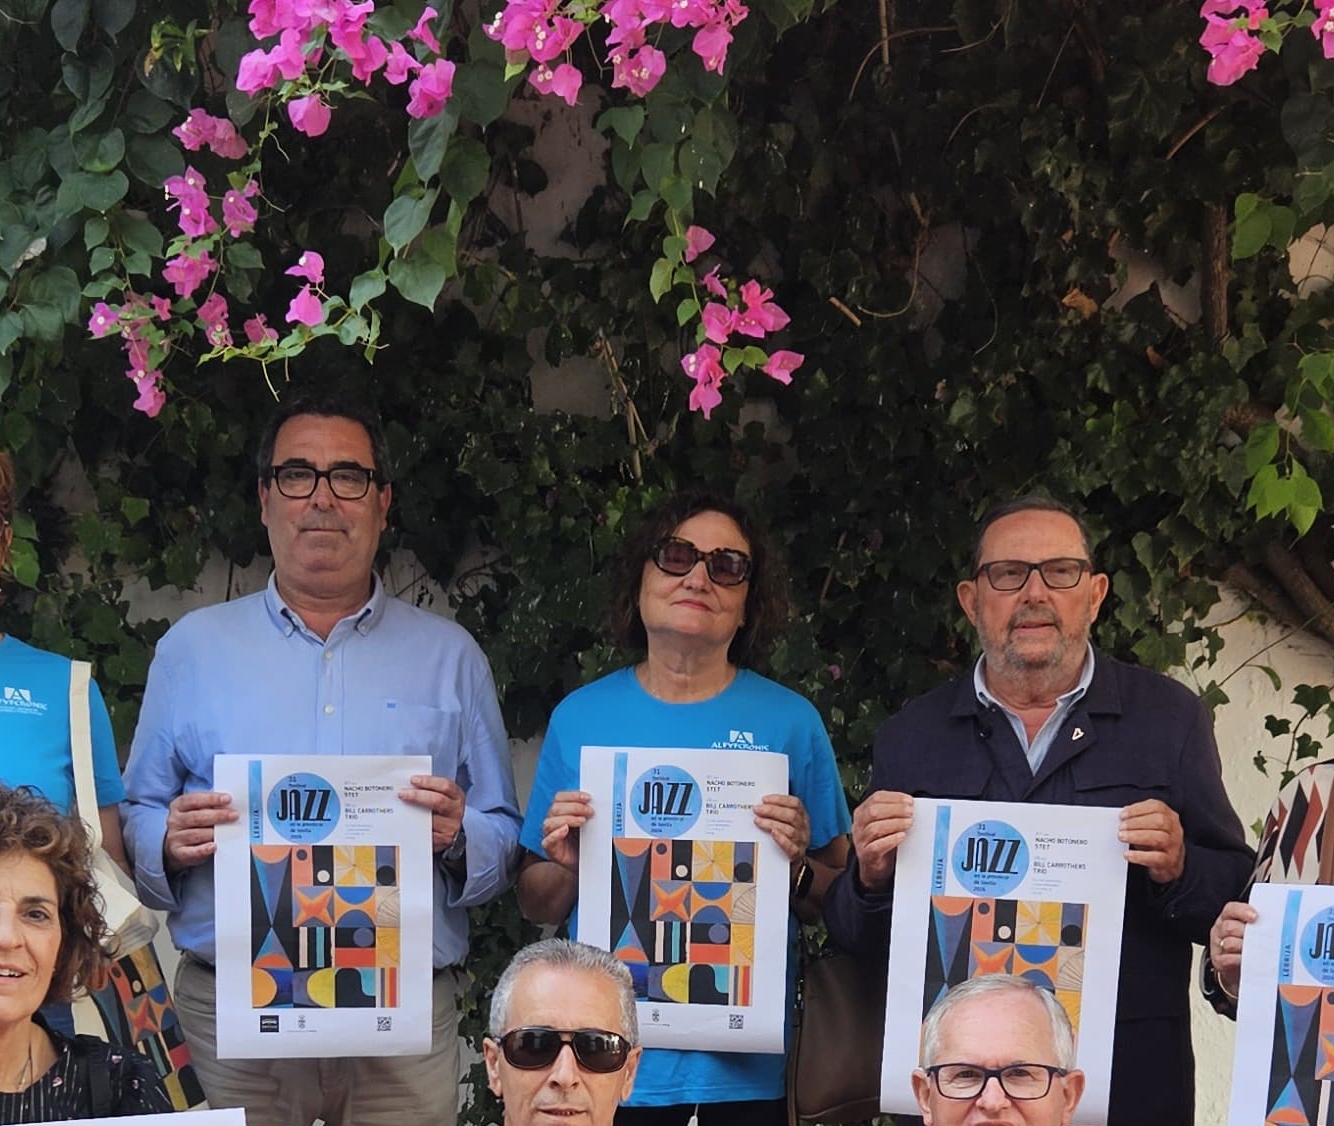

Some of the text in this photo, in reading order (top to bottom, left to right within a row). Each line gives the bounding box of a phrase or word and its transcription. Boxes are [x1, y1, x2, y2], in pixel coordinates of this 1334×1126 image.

[277, 789, 331, 821] JAZZ
[638, 782, 693, 815] JAZZ
[961, 837, 1021, 874] JAZZ
